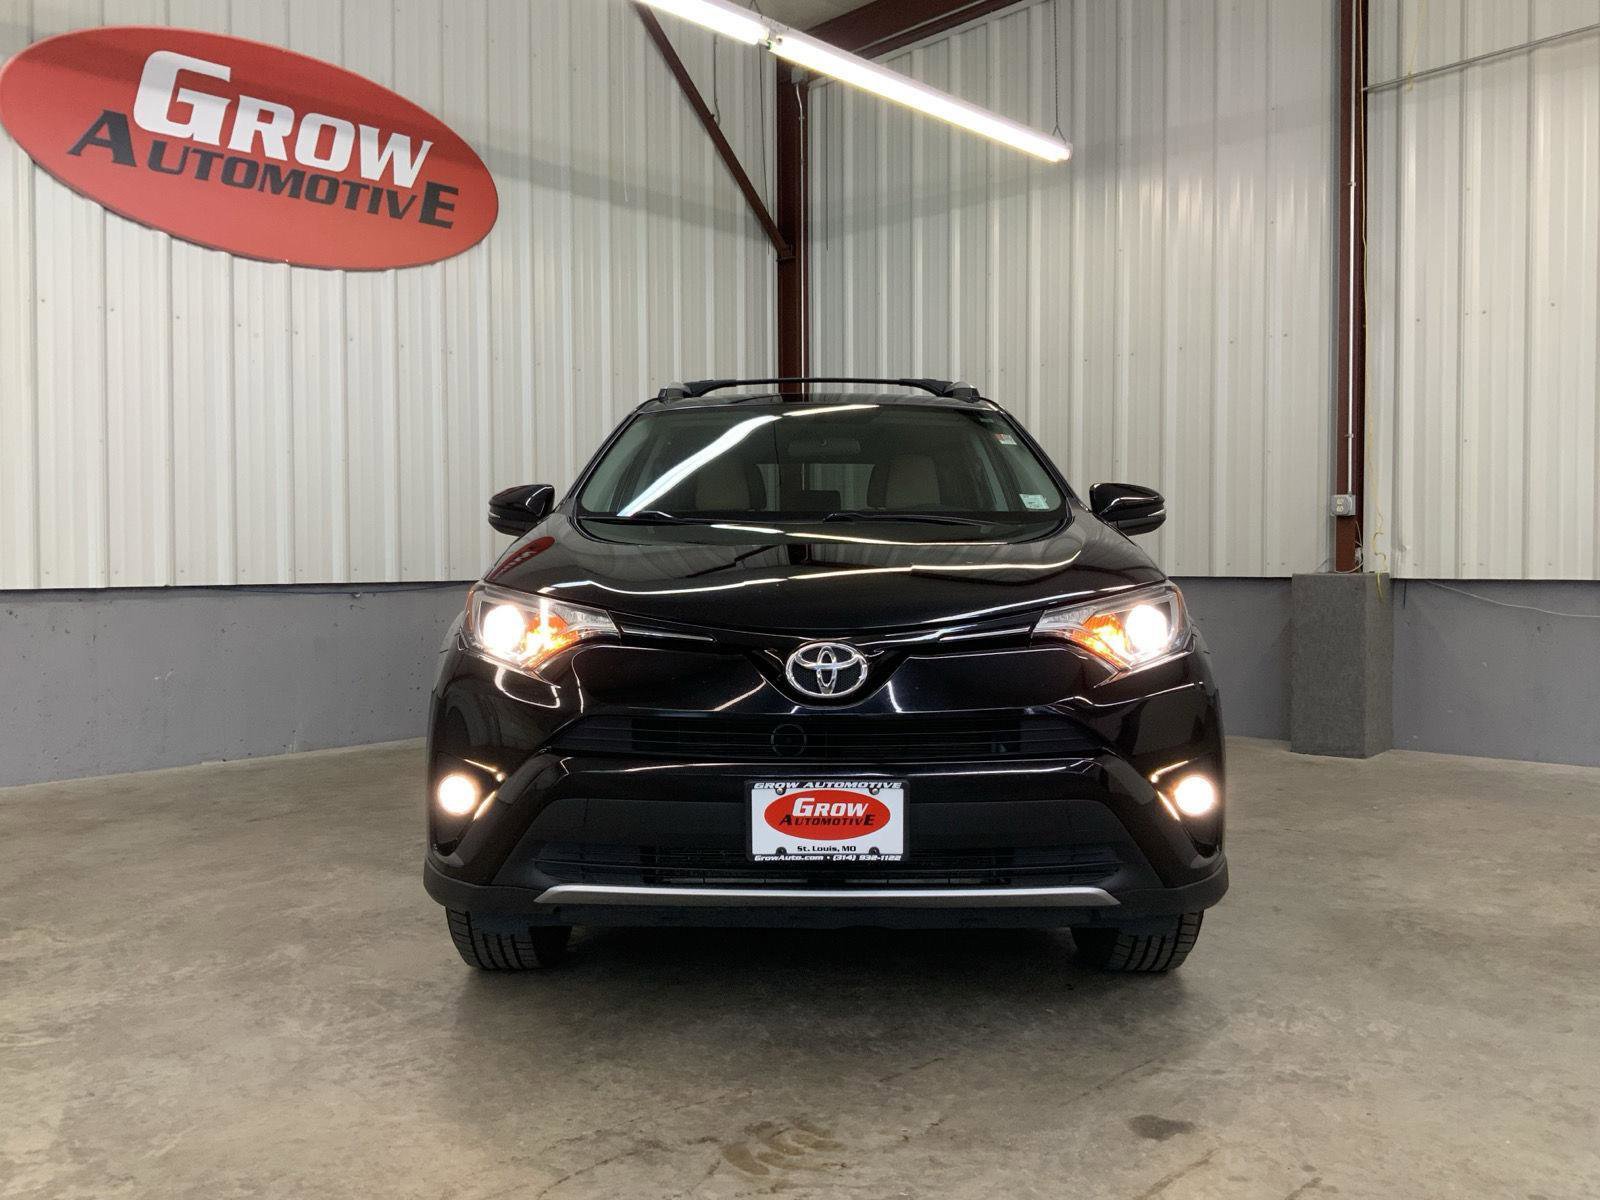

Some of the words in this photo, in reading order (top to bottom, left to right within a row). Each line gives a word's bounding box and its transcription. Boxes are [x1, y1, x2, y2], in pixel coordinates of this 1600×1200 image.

[133, 50, 433, 190] GROW
[67, 109, 460, 230] AUTOMOTIVE
[792, 797, 869, 817] GROW
[779, 814, 876, 826] AUTOMOTIVE
[812, 845, 840, 853] Louis,
[833, 854, 857, 862] (314)
